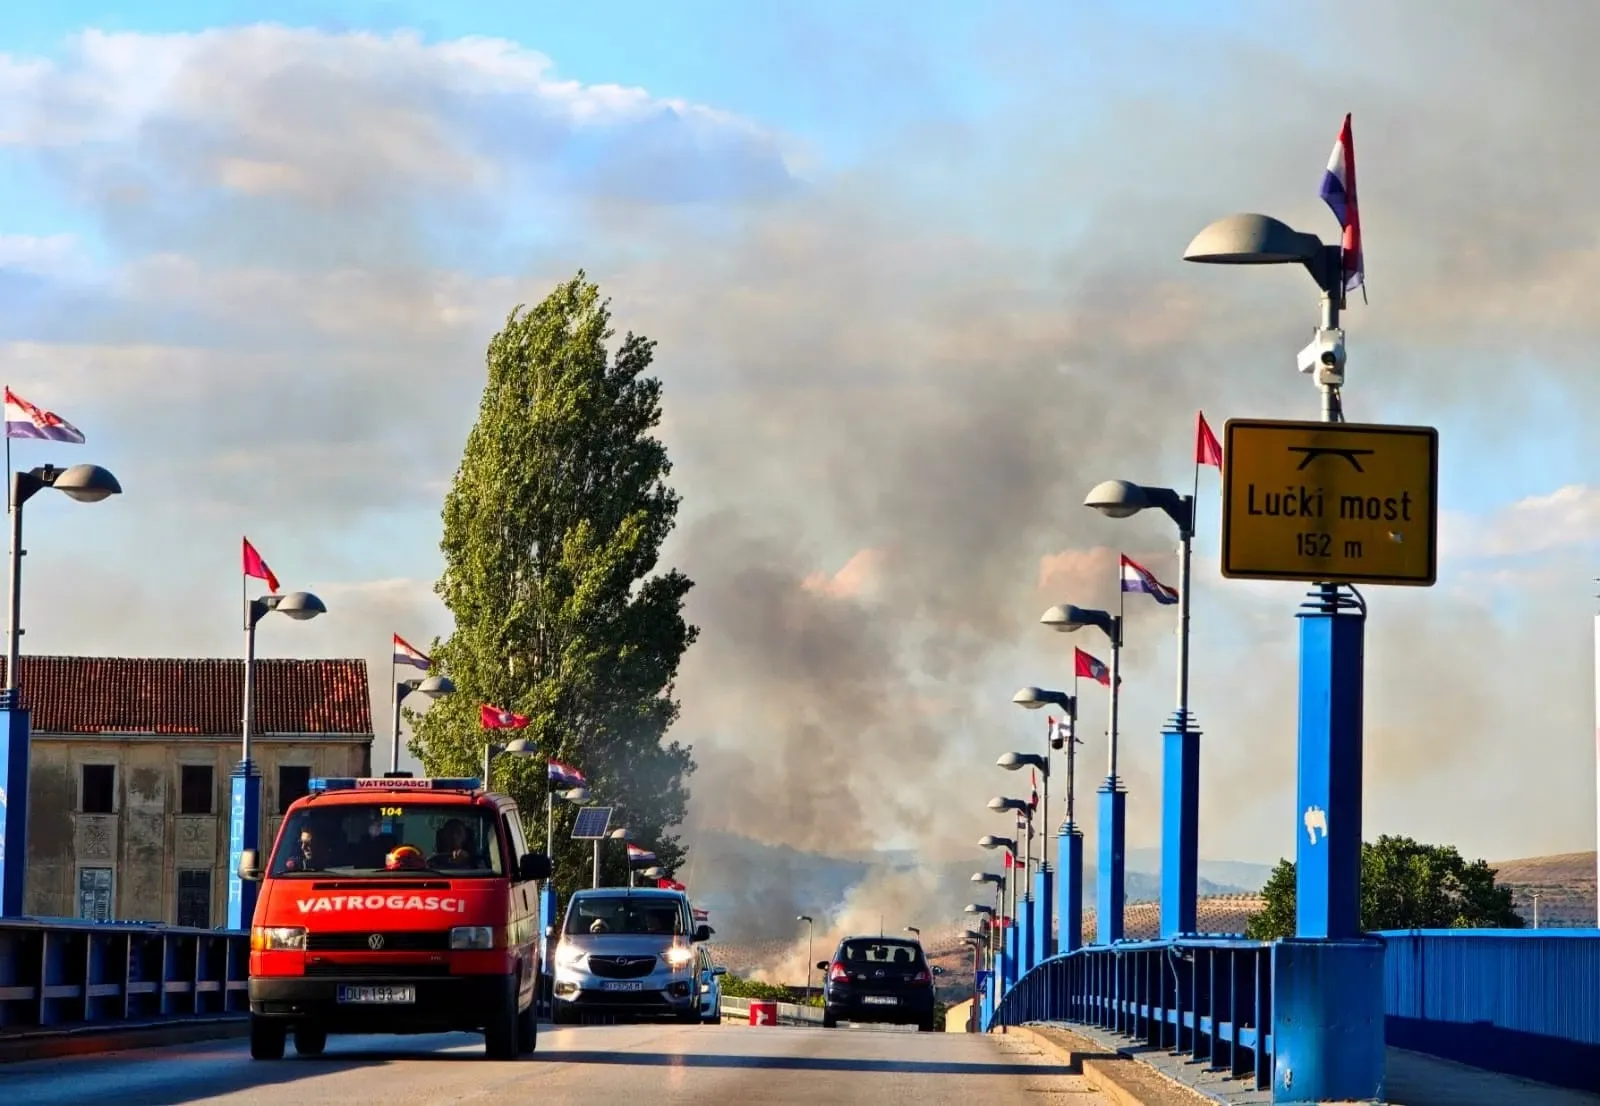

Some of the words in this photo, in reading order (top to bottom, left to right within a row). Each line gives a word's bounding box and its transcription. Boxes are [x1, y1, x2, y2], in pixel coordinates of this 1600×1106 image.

[1248, 484, 1324, 517] Lučki
[1340, 491, 1412, 522] most
[1297, 533, 1331, 557] 152
[1344, 541, 1363, 558] m
[358, 780, 429, 788] VATROGASCI
[380, 807, 402, 816] 104
[296, 895, 466, 913] VATROGASCI
